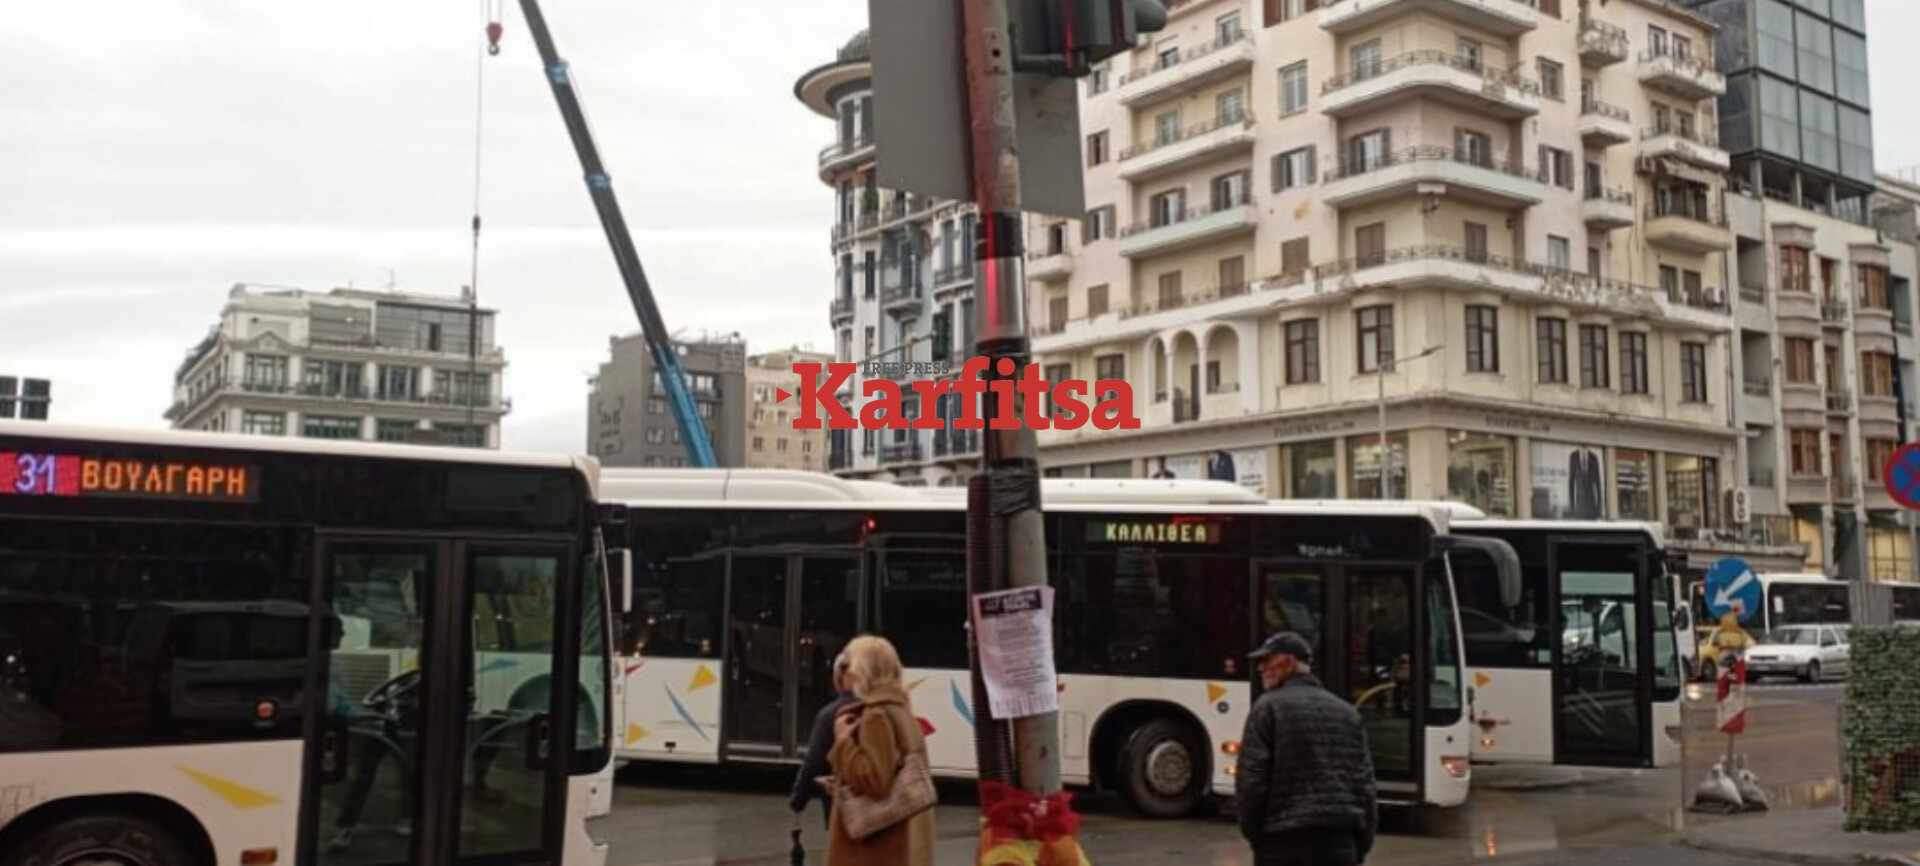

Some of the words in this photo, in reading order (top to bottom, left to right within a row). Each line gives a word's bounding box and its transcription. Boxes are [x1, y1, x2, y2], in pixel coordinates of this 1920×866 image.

[16, 453, 56, 493] 31
[82, 459, 245, 495] ΒΟΥΛΓΑΡΗ
[1106, 522, 1207, 542] ΚΑΛΛΙΘΕΑ
